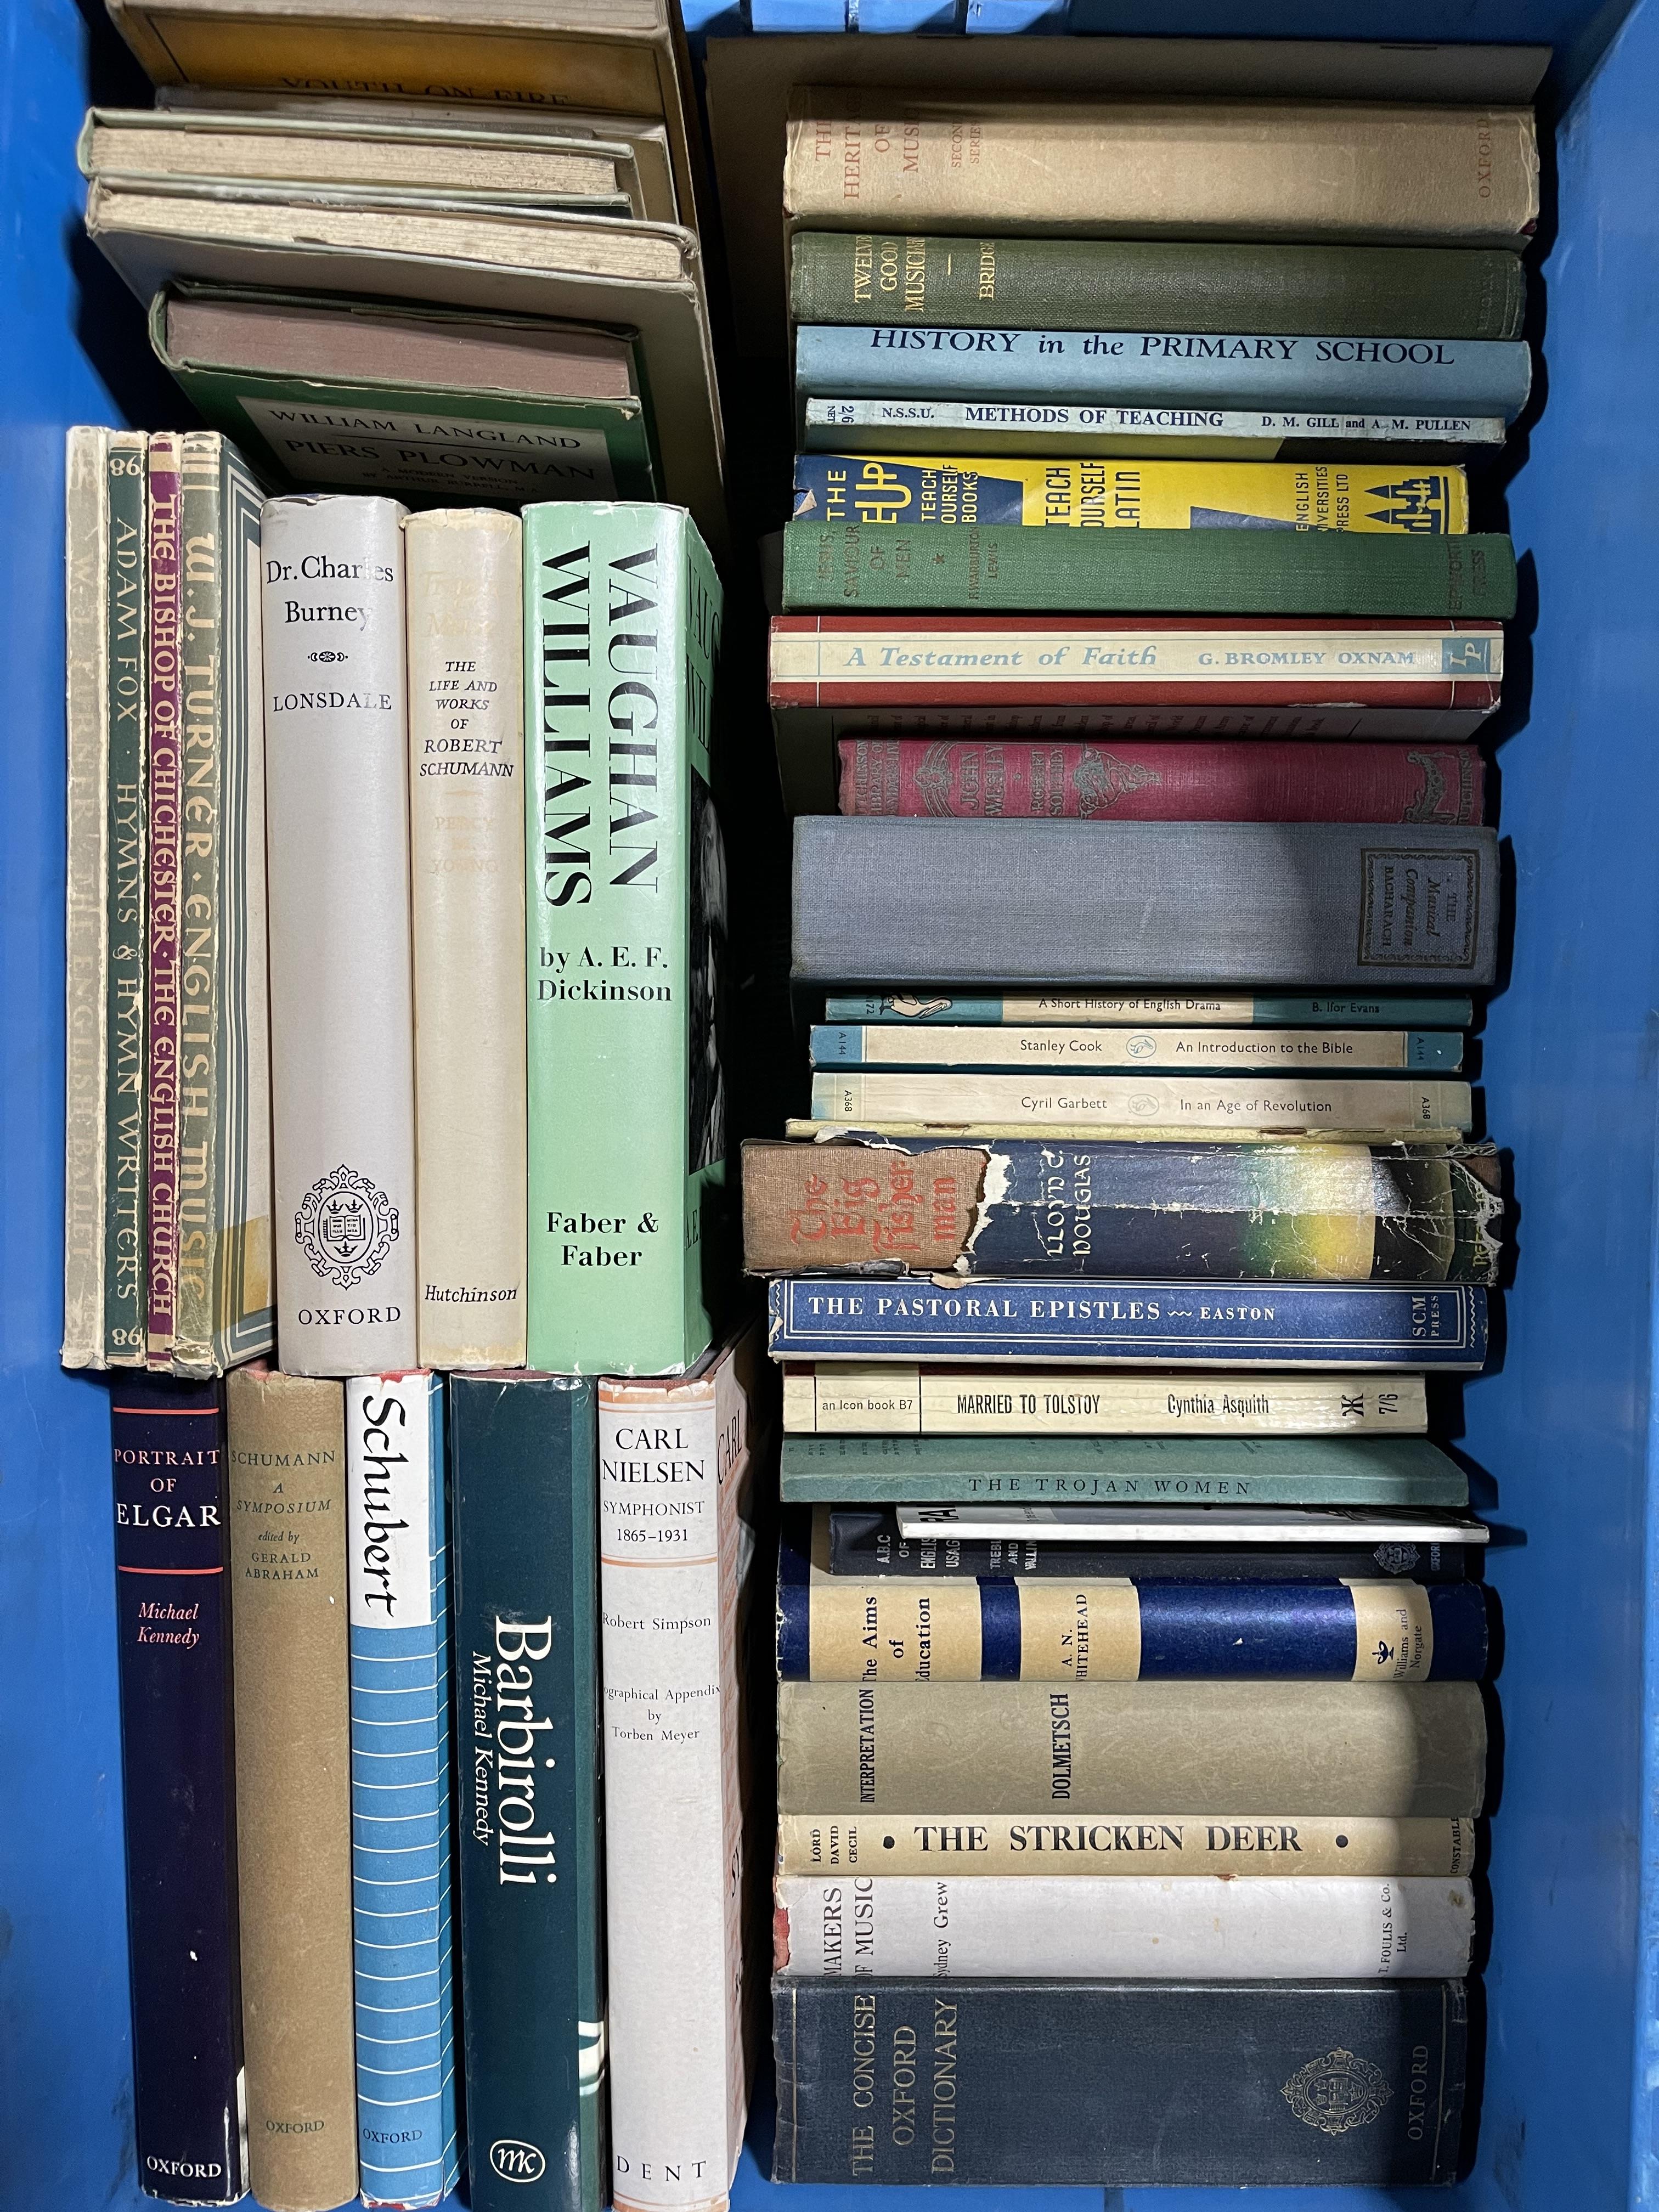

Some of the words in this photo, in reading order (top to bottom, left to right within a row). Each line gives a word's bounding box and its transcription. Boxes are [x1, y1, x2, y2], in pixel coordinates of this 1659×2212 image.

[875, 125, 890, 153] OF
[1477, 119, 1492, 198] OXFORD
[880, 242, 898, 292] GOOD
[870, 329, 1020, 353] HISTORY
[1038, 336, 1065, 354] in
[1082, 335, 1124, 356] the
[1140, 337, 1299, 361] PRIMARY
[1316, 341, 1454, 365] SCHOOL
[269, 410, 397, 432] WILLIAM
[414, 423, 581, 449] LANGLAND
[838, 406, 854, 423] 2/6
[882, 408, 934, 419] N.S.S.U.
[966, 407, 1069, 424] METHODS
[1080, 410, 1107, 425] OF
[1116, 410, 1223, 427] TEACHING
[284, 439, 380, 459] PIERS
[397, 450, 595, 480] PLOWMAN
[827, 470, 846, 522] THE
[921, 469, 937, 522] TEACH
[962, 471, 978, 523] BOOKS
[1296, 472, 1308, 531] ENGLISH
[152, 494, 177, 561] THE
[117, 518, 138, 640] ADAM
[266, 560, 298, 584] Dr.
[285, 601, 373, 631] Burney
[153, 573, 177, 692] BISHOP
[445, 662, 476, 673] THE
[843, 647, 866, 667] A
[879, 647, 1023, 667] Testament
[1038, 647, 1070, 667] of
[1082, 645, 1157, 667] Faith
[1199, 653, 1219, 665] G.
[1224, 652, 1327, 665] BROMLEY
[1339, 652, 1415, 664] OXNAM
[117, 657, 139, 721] FOX
[429, 680, 459, 691] LIFE
[464, 681, 497, 691] AND
[274, 692, 392, 712] LONSDALE
[436, 698, 489, 710] WORKS
[153, 700, 177, 740] OF
[450, 719, 469, 730] OF
[542, 540, 592, 906] WILLIAMS
[607, 543, 658, 893] VAUGHAN
[185, 654, 218, 859] TURNER
[424, 739, 503, 755] ROBERT
[420, 762, 514, 777] SCHUMANN
[117, 783, 138, 923] HYMNS
[151, 748, 177, 950] CHICHESTER
[1382, 866, 1394, 947] BACHARACH
[539, 946, 571, 974] by
[577, 947, 603, 967] A.
[611, 946, 636, 967] E.
[645, 946, 668, 969] F.
[153, 956, 176, 1025] THE
[181, 894, 209, 1116] ENGLISH
[538, 979, 672, 1001] Dickinson
[1039, 998, 1047, 1008] A
[1051, 998, 1080, 1009] Short
[1085, 998, 1124, 1011] History
[1128, 998, 1142, 1010] of
[1144, 999, 1181, 1012] English
[1185, 1000, 1221, 1011] Drama
[117, 979, 138, 1094] HYMN
[1020, 1040, 1065, 1055] Stanley
[1069, 1040, 1102, 1052] Cook
[1176, 1042, 1193, 1054] An
[1198, 1041, 1277, 1054] Introduction
[1280, 1043, 1293, 1054] to
[1297, 1042, 1318, 1054] the
[1322, 1042, 1353, 1054] Bible
[151, 1036, 176, 1172] ENGLISH
[844, 1090, 852, 1112] A368
[1022, 1096, 1052, 1111] Cyril
[1058, 1097, 1108, 1109] Garbett
[1180, 1100, 1192, 1111] In
[1197, 1103, 1211, 1111] an
[1217, 1101, 1241, 1114] Age
[1245, 1099, 1258, 1111] of
[1263, 1100, 1331, 1113] Revolution
[117, 1112, 139, 1300] WRITERS
[178, 1141, 208, 1300] MUSIC
[1072, 1155, 1091, 1256] DOUGLAS
[546, 1211, 627, 1234] Faber
[637, 1212, 659, 1234] &
[151, 1182, 172, 1316] CHURCH
[561, 1245, 642, 1267] Faber
[425, 1285, 517, 1304] Hutchinson
[809, 1296, 864, 1316] THE
[877, 1299, 1018, 1318] PASTORAL
[1030, 1300, 1159, 1321] EPISTLES
[1200, 1307, 1276, 1321] EASTON
[298, 1306, 401, 1325] OXFORD
[1412, 1296, 1426, 1338] SCM
[1430, 1295, 1439, 1338] PRESS
[822, 1401, 836, 1410] an
[839, 1400, 863, 1410] Icon
[867, 1400, 895, 1410] book
[899, 1400, 913, 1410] B7
[957, 1394, 1013, 1415] MARRIED
[1021, 1394, 1036, 1414] TO
[1045, 1394, 1100, 1414] TOLSTOY
[1167, 1393, 1215, 1415] Cynthia
[1222, 1394, 1269, 1418] Asquith
[616, 1428, 689, 1451] CARL
[114, 1448, 219, 1465] PORTRAIT
[231, 1451, 336, 1467] SCHUMANN
[602, 1460, 705, 1482] NIELSEN
[150, 1479, 176, 1493] OF
[274, 1483, 284, 1493] A
[969, 1479, 1021, 1492] THE
[1036, 1479, 1140, 1495] TROJAN
[1154, 1480, 1250, 1495] WOMEN
[117, 1503, 221, 1527] ELGAR
[237, 1500, 331, 1514] SYMPOSIUM
[362, 1395, 409, 1617] Schubert
[603, 1500, 705, 1515] SYMPHONIST
[252, 1552, 311, 1564] GERALD
[899, 1541, 910, 1558] OF
[1008, 1543, 1018, 1565] AND
[245, 1567, 319, 1580] ABRAHAM
[138, 1602, 199, 1620] Michael
[602, 1612, 645, 1630] Robert
[652, 1615, 711, 1633] Simpson
[862, 1596, 877, 1649] Aims
[1396, 1608, 1408, 1630] and
[137, 1627, 200, 1649] Kennedy
[889, 1639, 904, 1659] of
[1409, 1625, 1425, 1668] Norgate
[1393, 1640, 1408, 1679] Williams
[472, 1651, 493, 1740] Michael
[496, 1615, 556, 1885] Barbirolli
[859, 1689, 875, 1803] INTERPRETATION
[1050, 1693, 1070, 1799] DOLMETSCH
[472, 1746, 494, 1846] Kennedy
[811, 1829, 821, 1863] LORD
[831, 1825, 839, 1864] DAVID
[849, 1826, 857, 1864] CECIL
[913, 1825, 989, 1852] THE
[1010, 1825, 1184, 1851] STRICKEN
[1205, 1825, 1303, 1851] DEER
[1451, 1816, 1460, 1874] CONSTABLE
[854, 1877, 874, 1956] MUSIC
[934, 1882, 948, 1928] Grew
[853, 1994, 876, 2107] CONCISE
[893, 2025, 917, 2145] OXFORD
[932, 1998, 957, 2174] DICTIONARY
[1407, 2045, 1428, 2141] OXFORD
[266, 2120, 324, 2134] OXFORD
[363, 2129, 422, 2143] OXFORD
[852, 2125, 874, 2176] THE
[147, 2157, 221, 2178] OXFORD
[617, 2154, 706, 2181] DENT
